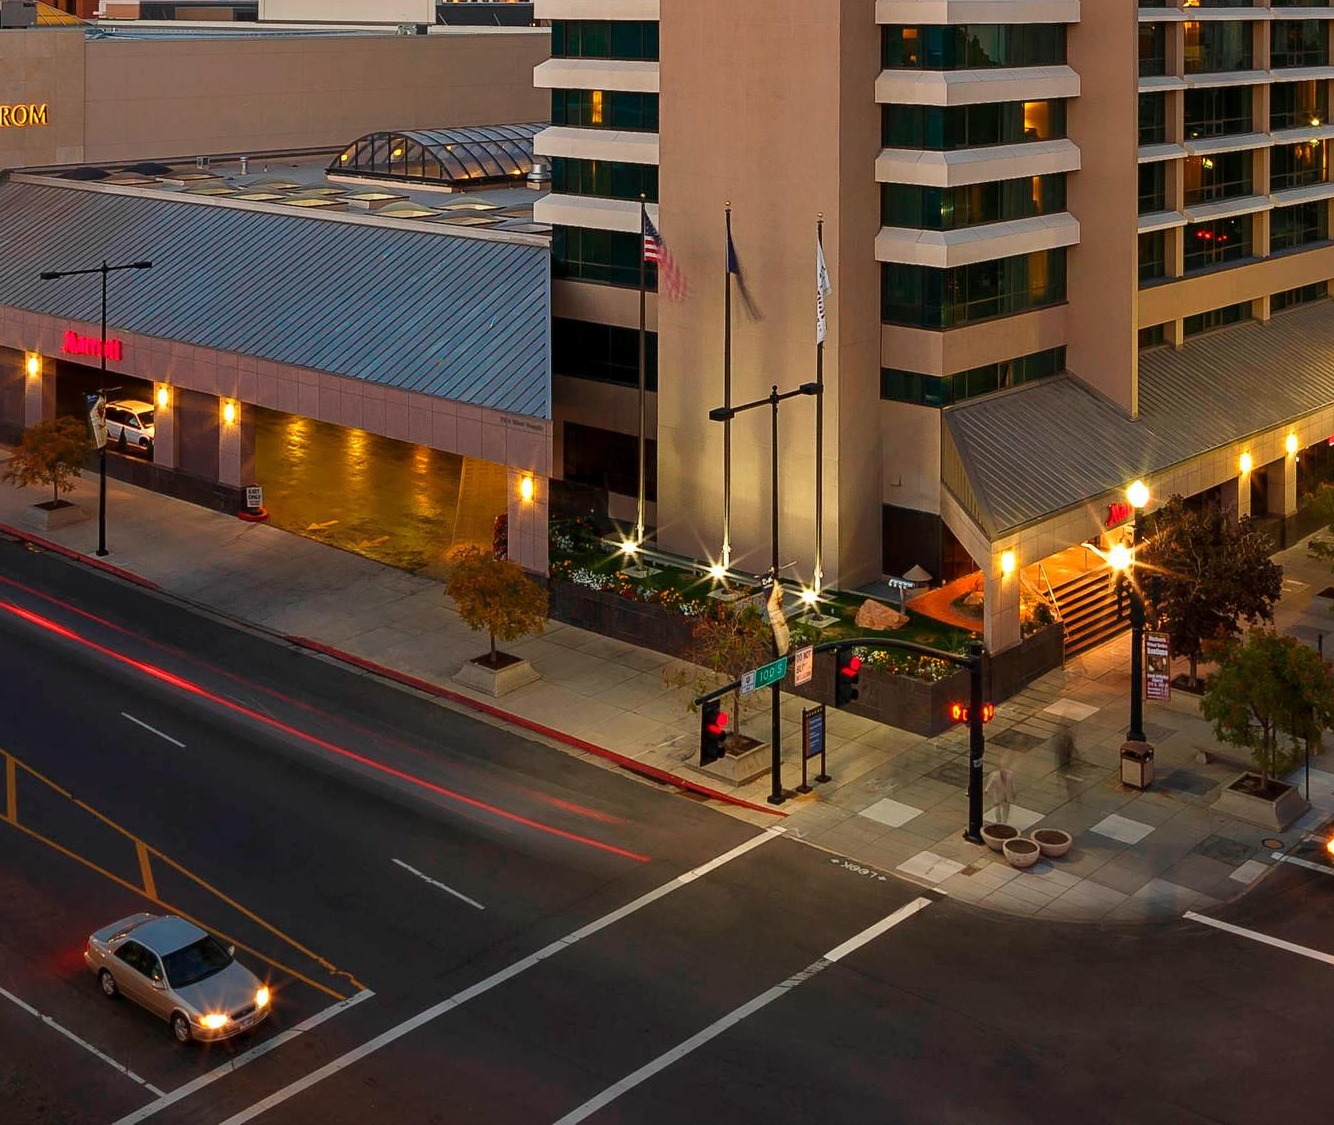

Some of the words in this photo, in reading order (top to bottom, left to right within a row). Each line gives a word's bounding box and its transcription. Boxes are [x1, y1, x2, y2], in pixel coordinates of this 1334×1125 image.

[759, 667, 775, 682] 100
[776, 663, 783, 675] S
[840, 861, 878, 879] LOOK
